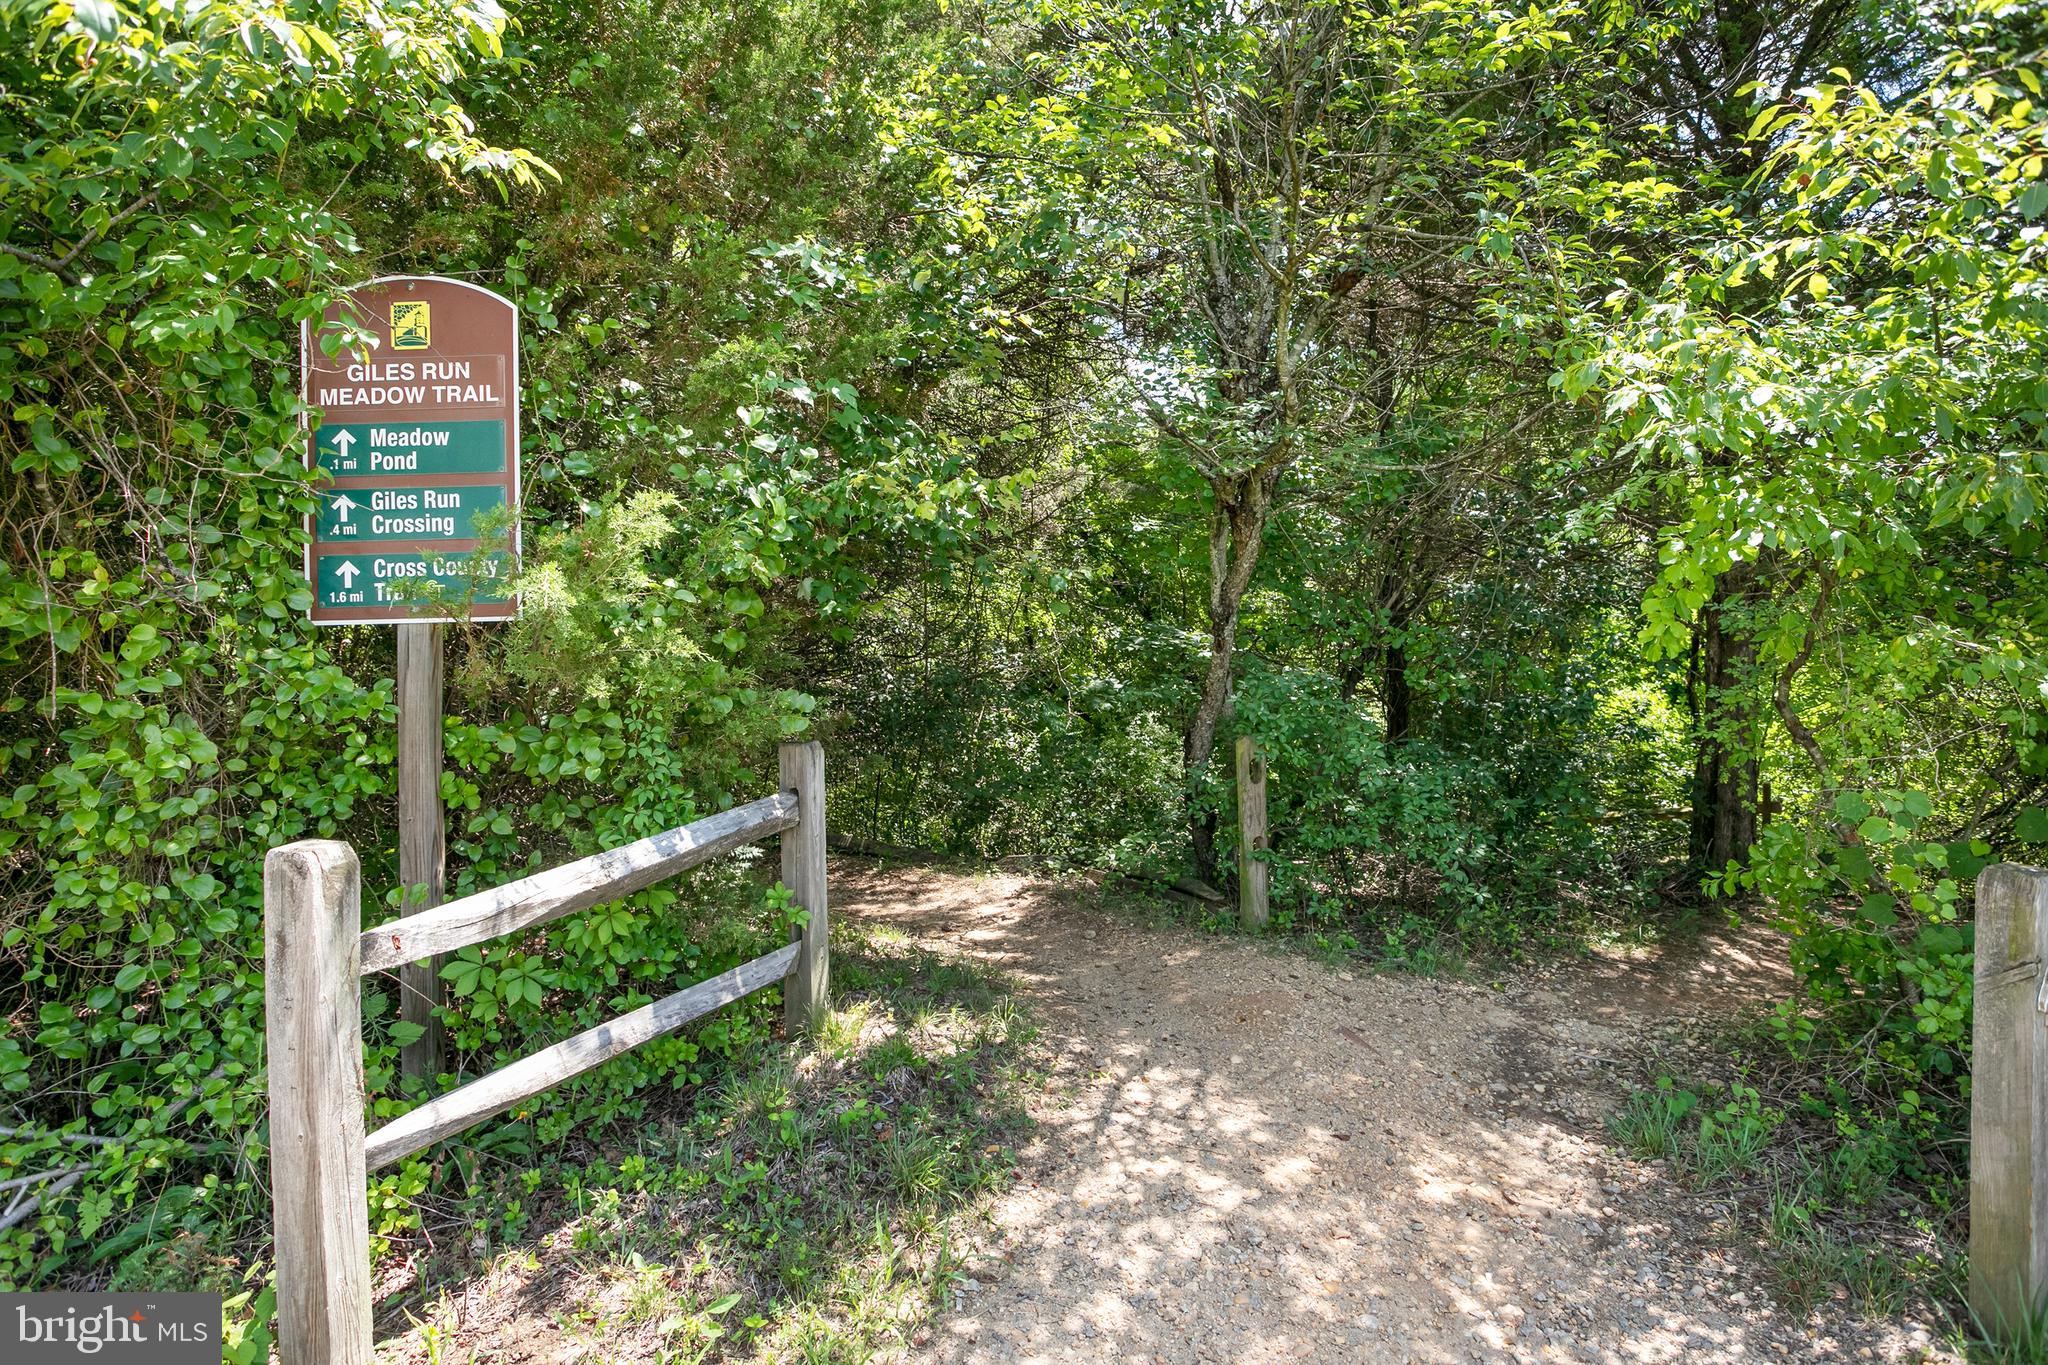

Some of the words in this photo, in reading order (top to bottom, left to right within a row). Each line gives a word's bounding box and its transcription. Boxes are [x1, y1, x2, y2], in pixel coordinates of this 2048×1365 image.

[346, 362, 416, 382] GILES
[422, 361, 470, 380] RUN
[319, 386, 426, 406] MEADOW
[431, 384, 499, 403] TRAIL
[370, 427, 450, 447] Meadow
[343, 458, 357, 469] mi
[370, 450, 417, 470] Pond
[371, 490, 418, 510] Giles
[424, 490, 460, 509] Run
[329, 524, 340, 536] .4
[343, 523, 357, 535] mi
[371, 513, 455, 536] Crossing
[373, 558, 427, 578] Cross
[329, 591, 347, 603] 1.6
[350, 590, 363, 602] mi
